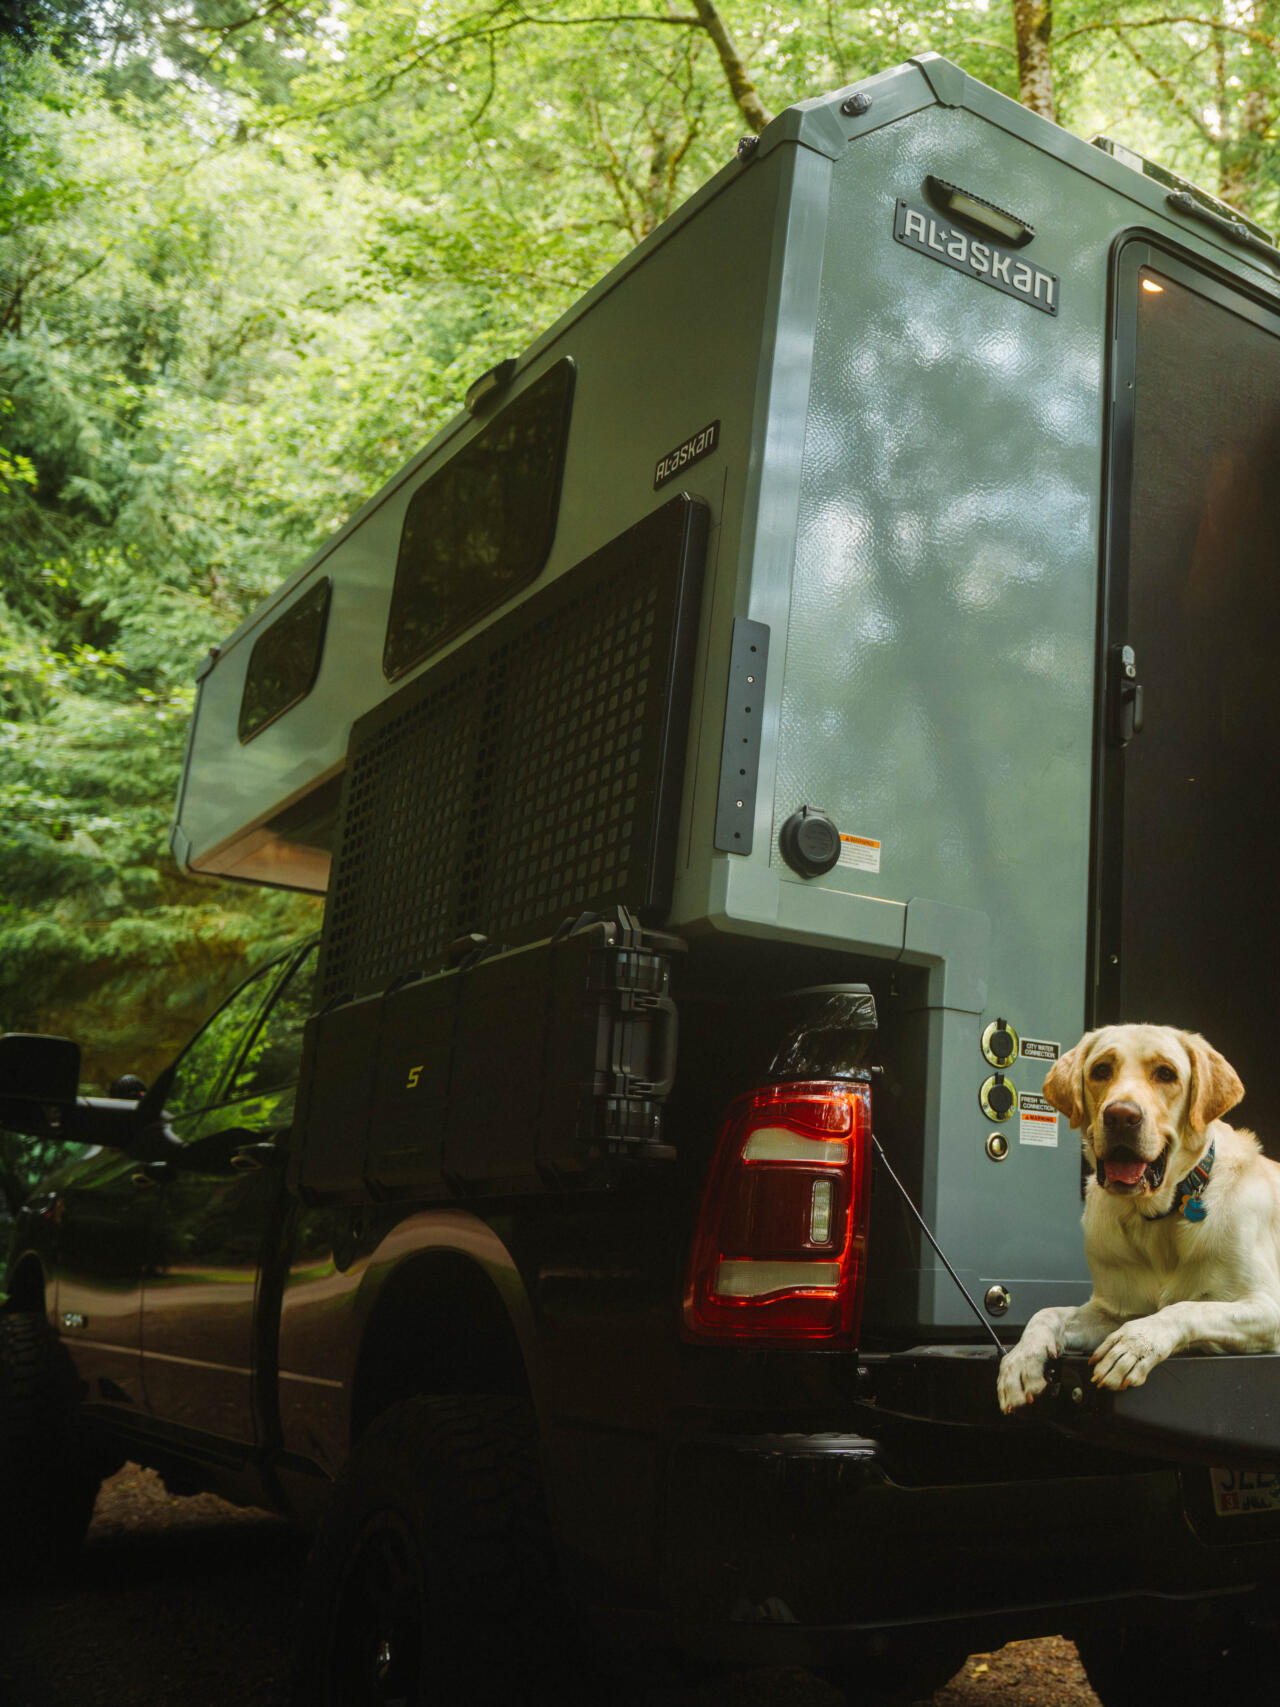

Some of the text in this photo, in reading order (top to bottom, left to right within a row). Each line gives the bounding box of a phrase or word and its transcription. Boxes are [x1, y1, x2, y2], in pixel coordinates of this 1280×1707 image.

[1038, 1044, 1054, 1052] WATER
[1024, 1049, 1056, 1058] CONNECTION
[1020, 1096, 1038, 1104] FRESH
